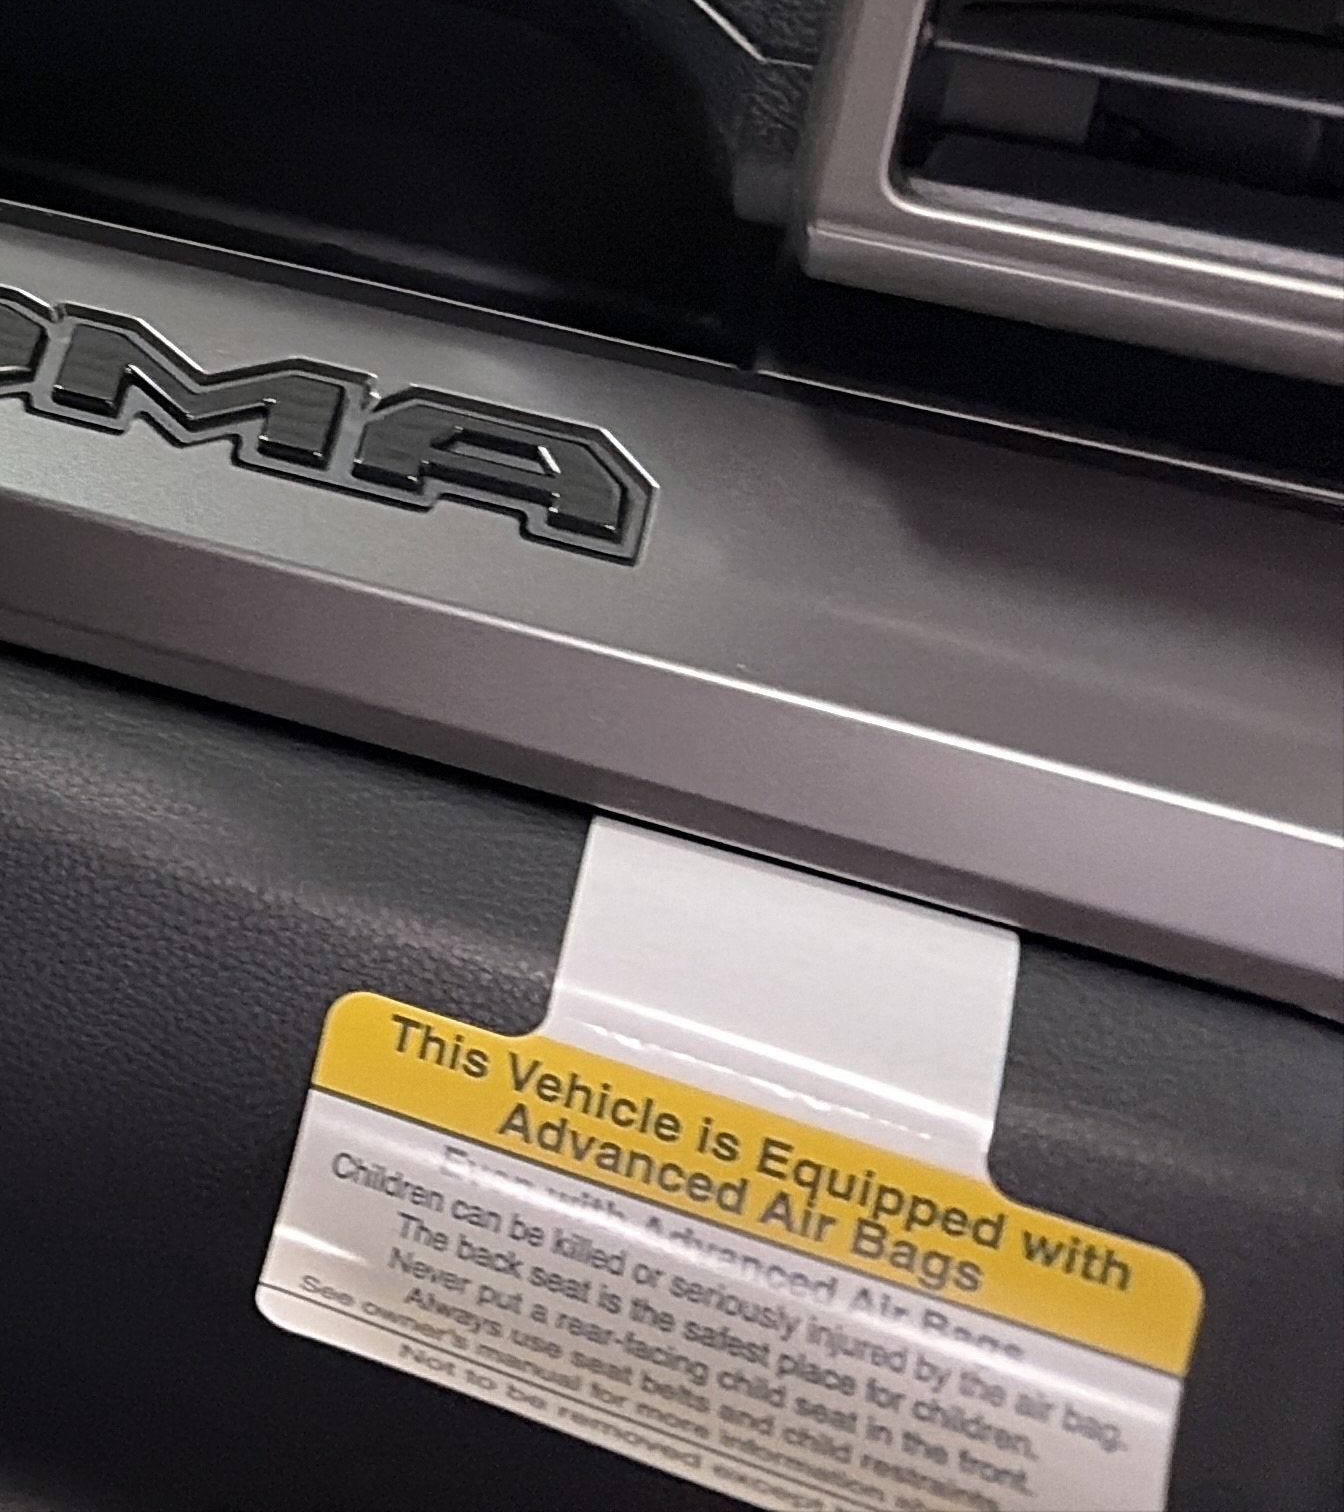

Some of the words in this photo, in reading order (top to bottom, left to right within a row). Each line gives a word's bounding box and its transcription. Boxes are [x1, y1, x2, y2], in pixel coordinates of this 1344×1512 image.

[390, 1012, 491, 1079] This
[507, 1050, 682, 1143] Vehicle
[697, 1115, 741, 1163] is
[756, 1136, 1008, 1251] Equipped
[1022, 1228, 1133, 1292] with
[496, 1101, 750, 1215] Advanced
[758, 1189, 839, 1243] Air
[850, 1216, 985, 1292] Bags
[299, 1273, 355, 1308] See
[362, 1300, 469, 1351] owner's
[475, 1343, 582, 1390] manual
[331, 1151, 444, 1213] Children
[450, 1194, 502, 1234] can
[511, 1211, 545, 1248] be
[550, 1227, 627, 1277] killed
[632, 1262, 665, 1288] or
[670, 1274, 802, 1340] seriously
[807, 1315, 908, 1373] injured
[914, 1352, 951, 1394] by
[959, 1369, 1007, 1407] the
[387, 1246, 473, 1296] Never
[476, 1282, 523, 1317] put
[529, 1302, 549, 1325] a
[555, 1309, 710, 1388] rear-facing
[716, 1367, 788, 1410] child
[794, 1395, 859, 1435] seat
[864, 1416, 894, 1447] in
[397, 1210, 449, 1252] The
[456, 1232, 524, 1280] back
[528, 1265, 591, 1304] seat
[598, 1284, 623, 1315] is
[628, 1298, 677, 1333] the
[683, 1320, 771, 1369] safest
[776, 1351, 857, 1397] place
[865, 1376, 906, 1412] for
[404, 1286, 504, 1339] Always
[510, 1327, 565, 1360] use
[570, 1348, 634, 1386] seat
[638, 1368, 712, 1415] belts
[717, 1402, 776, 1437] and
[398, 1343, 457, 1378] Not
[464, 1368, 498, 1391] to
[505, 1384, 547, 1411] be
[557, 1405, 702, 1469] removed
